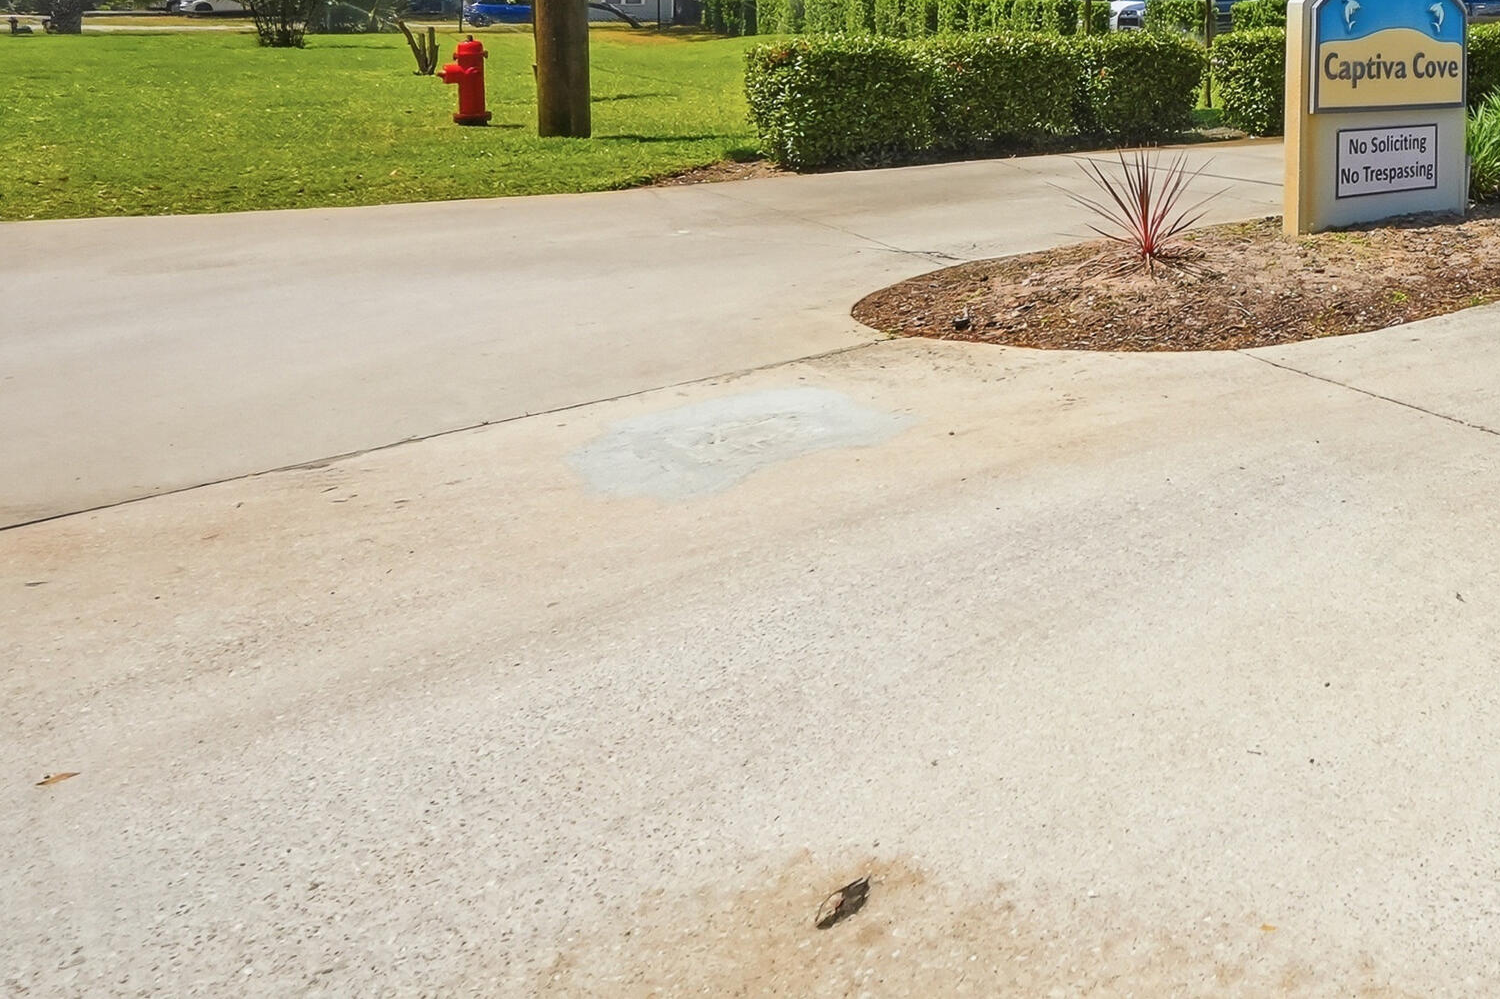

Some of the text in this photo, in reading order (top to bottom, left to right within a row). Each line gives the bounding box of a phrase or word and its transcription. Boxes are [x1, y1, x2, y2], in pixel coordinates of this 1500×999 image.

[1324, 52, 1459, 89] Captiva Cove
[1349, 134, 1427, 155] No Soliciting
[1341, 161, 1434, 184] No Trespassing
